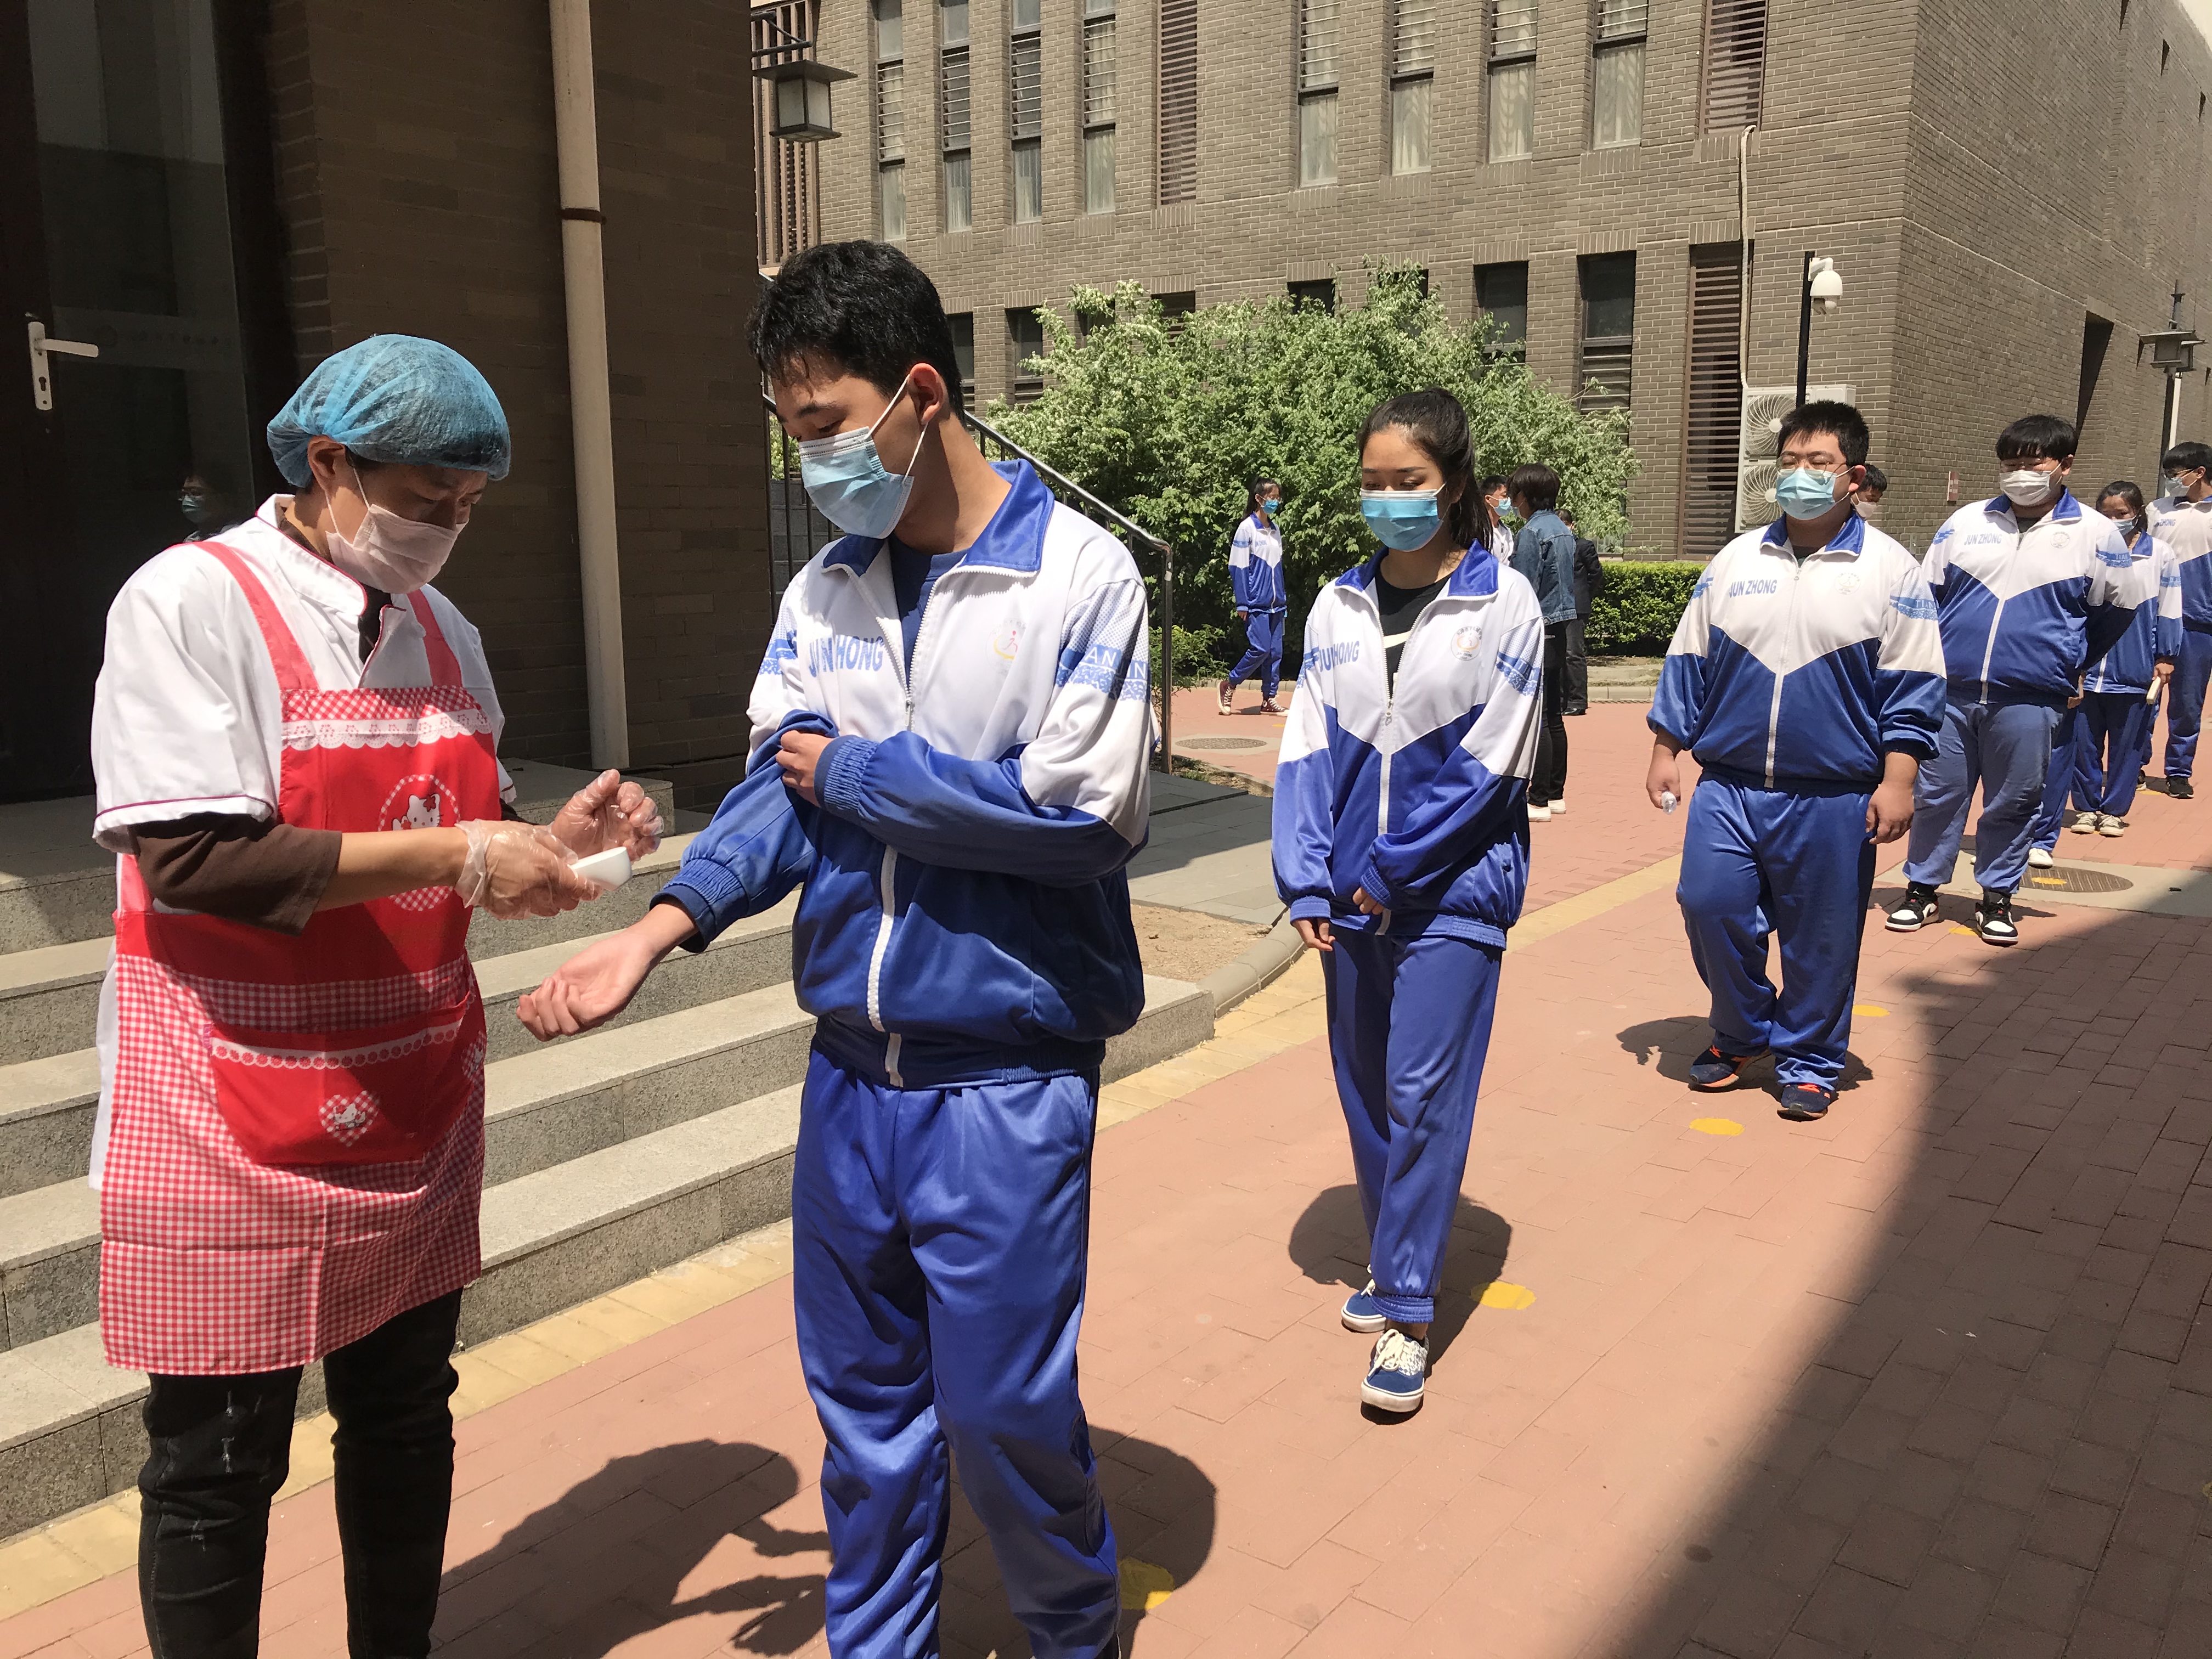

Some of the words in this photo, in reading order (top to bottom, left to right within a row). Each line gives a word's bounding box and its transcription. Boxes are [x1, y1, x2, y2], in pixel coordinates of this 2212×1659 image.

[1964, 534, 1978, 546] JUN
[1978, 533, 2002, 544] ZHONG
[1729, 581, 1745, 598] JUN
[1745, 579, 1778, 595] ZHONG
[836, 634, 884, 672] HONG
[1333, 640, 1359, 667] HONG
